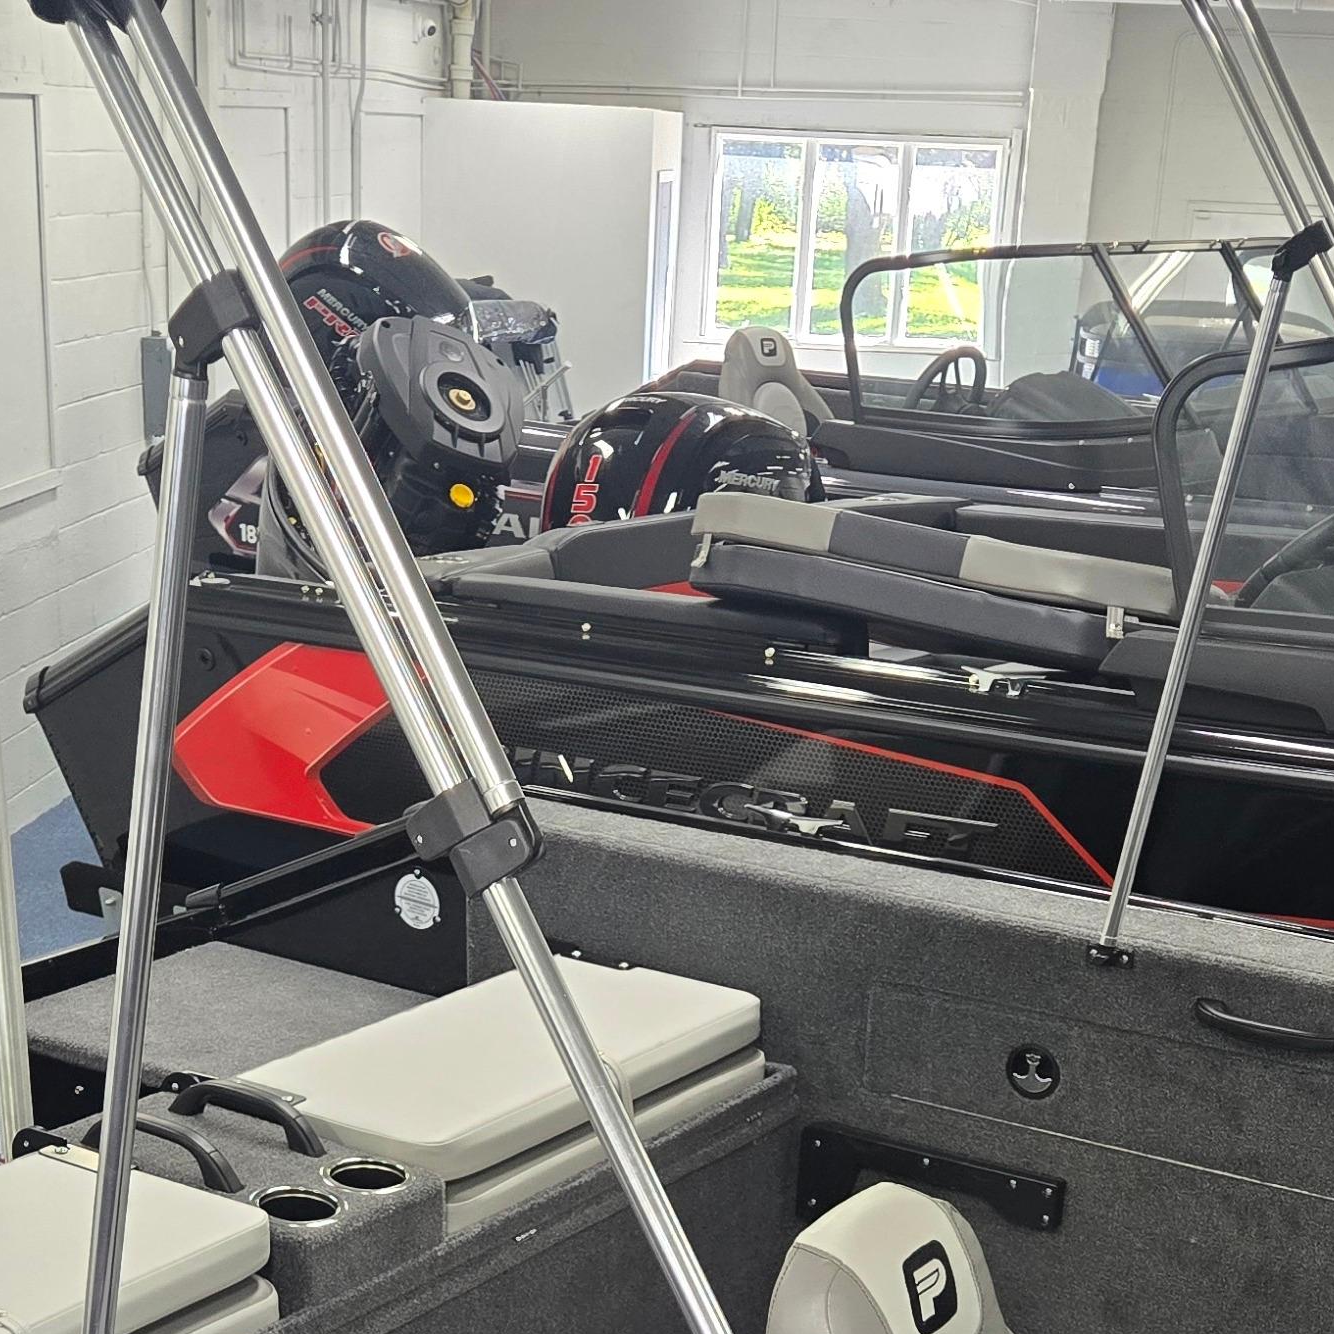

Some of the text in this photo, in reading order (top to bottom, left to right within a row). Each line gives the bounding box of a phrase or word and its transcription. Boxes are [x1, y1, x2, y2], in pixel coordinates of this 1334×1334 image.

[317, 288, 368, 331] MERCURY
[717, 470, 780, 492] MERCURY
[238, 522, 259, 545] 18
